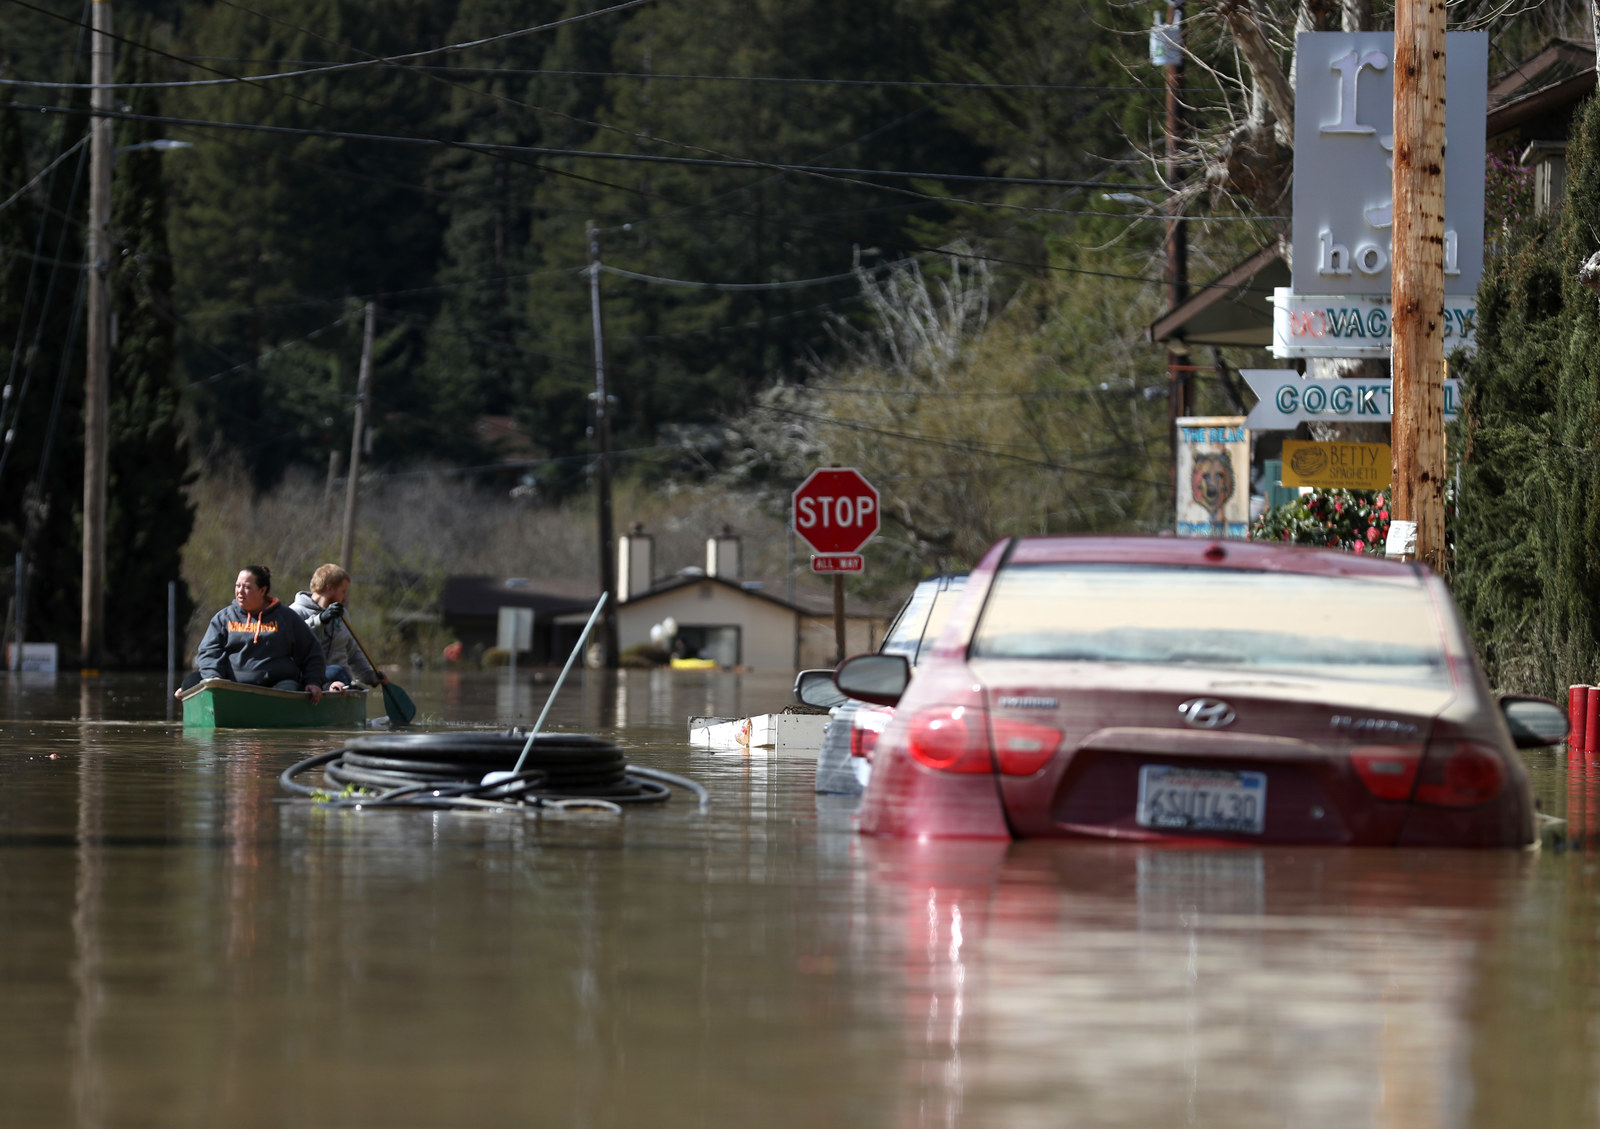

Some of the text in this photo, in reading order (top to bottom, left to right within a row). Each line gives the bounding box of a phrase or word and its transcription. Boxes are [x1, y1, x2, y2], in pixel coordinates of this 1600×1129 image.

[1317, 229, 1460, 275] hol
[1326, 307, 1477, 339] VACY
[1276, 384, 1459, 415] COCKL
[1330, 445, 1379, 466] BETTY
[1329, 466, 1378, 481] SPAGHETTI
[799, 496, 874, 528] STOP
[816, 559, 859, 568] ALL WAY
